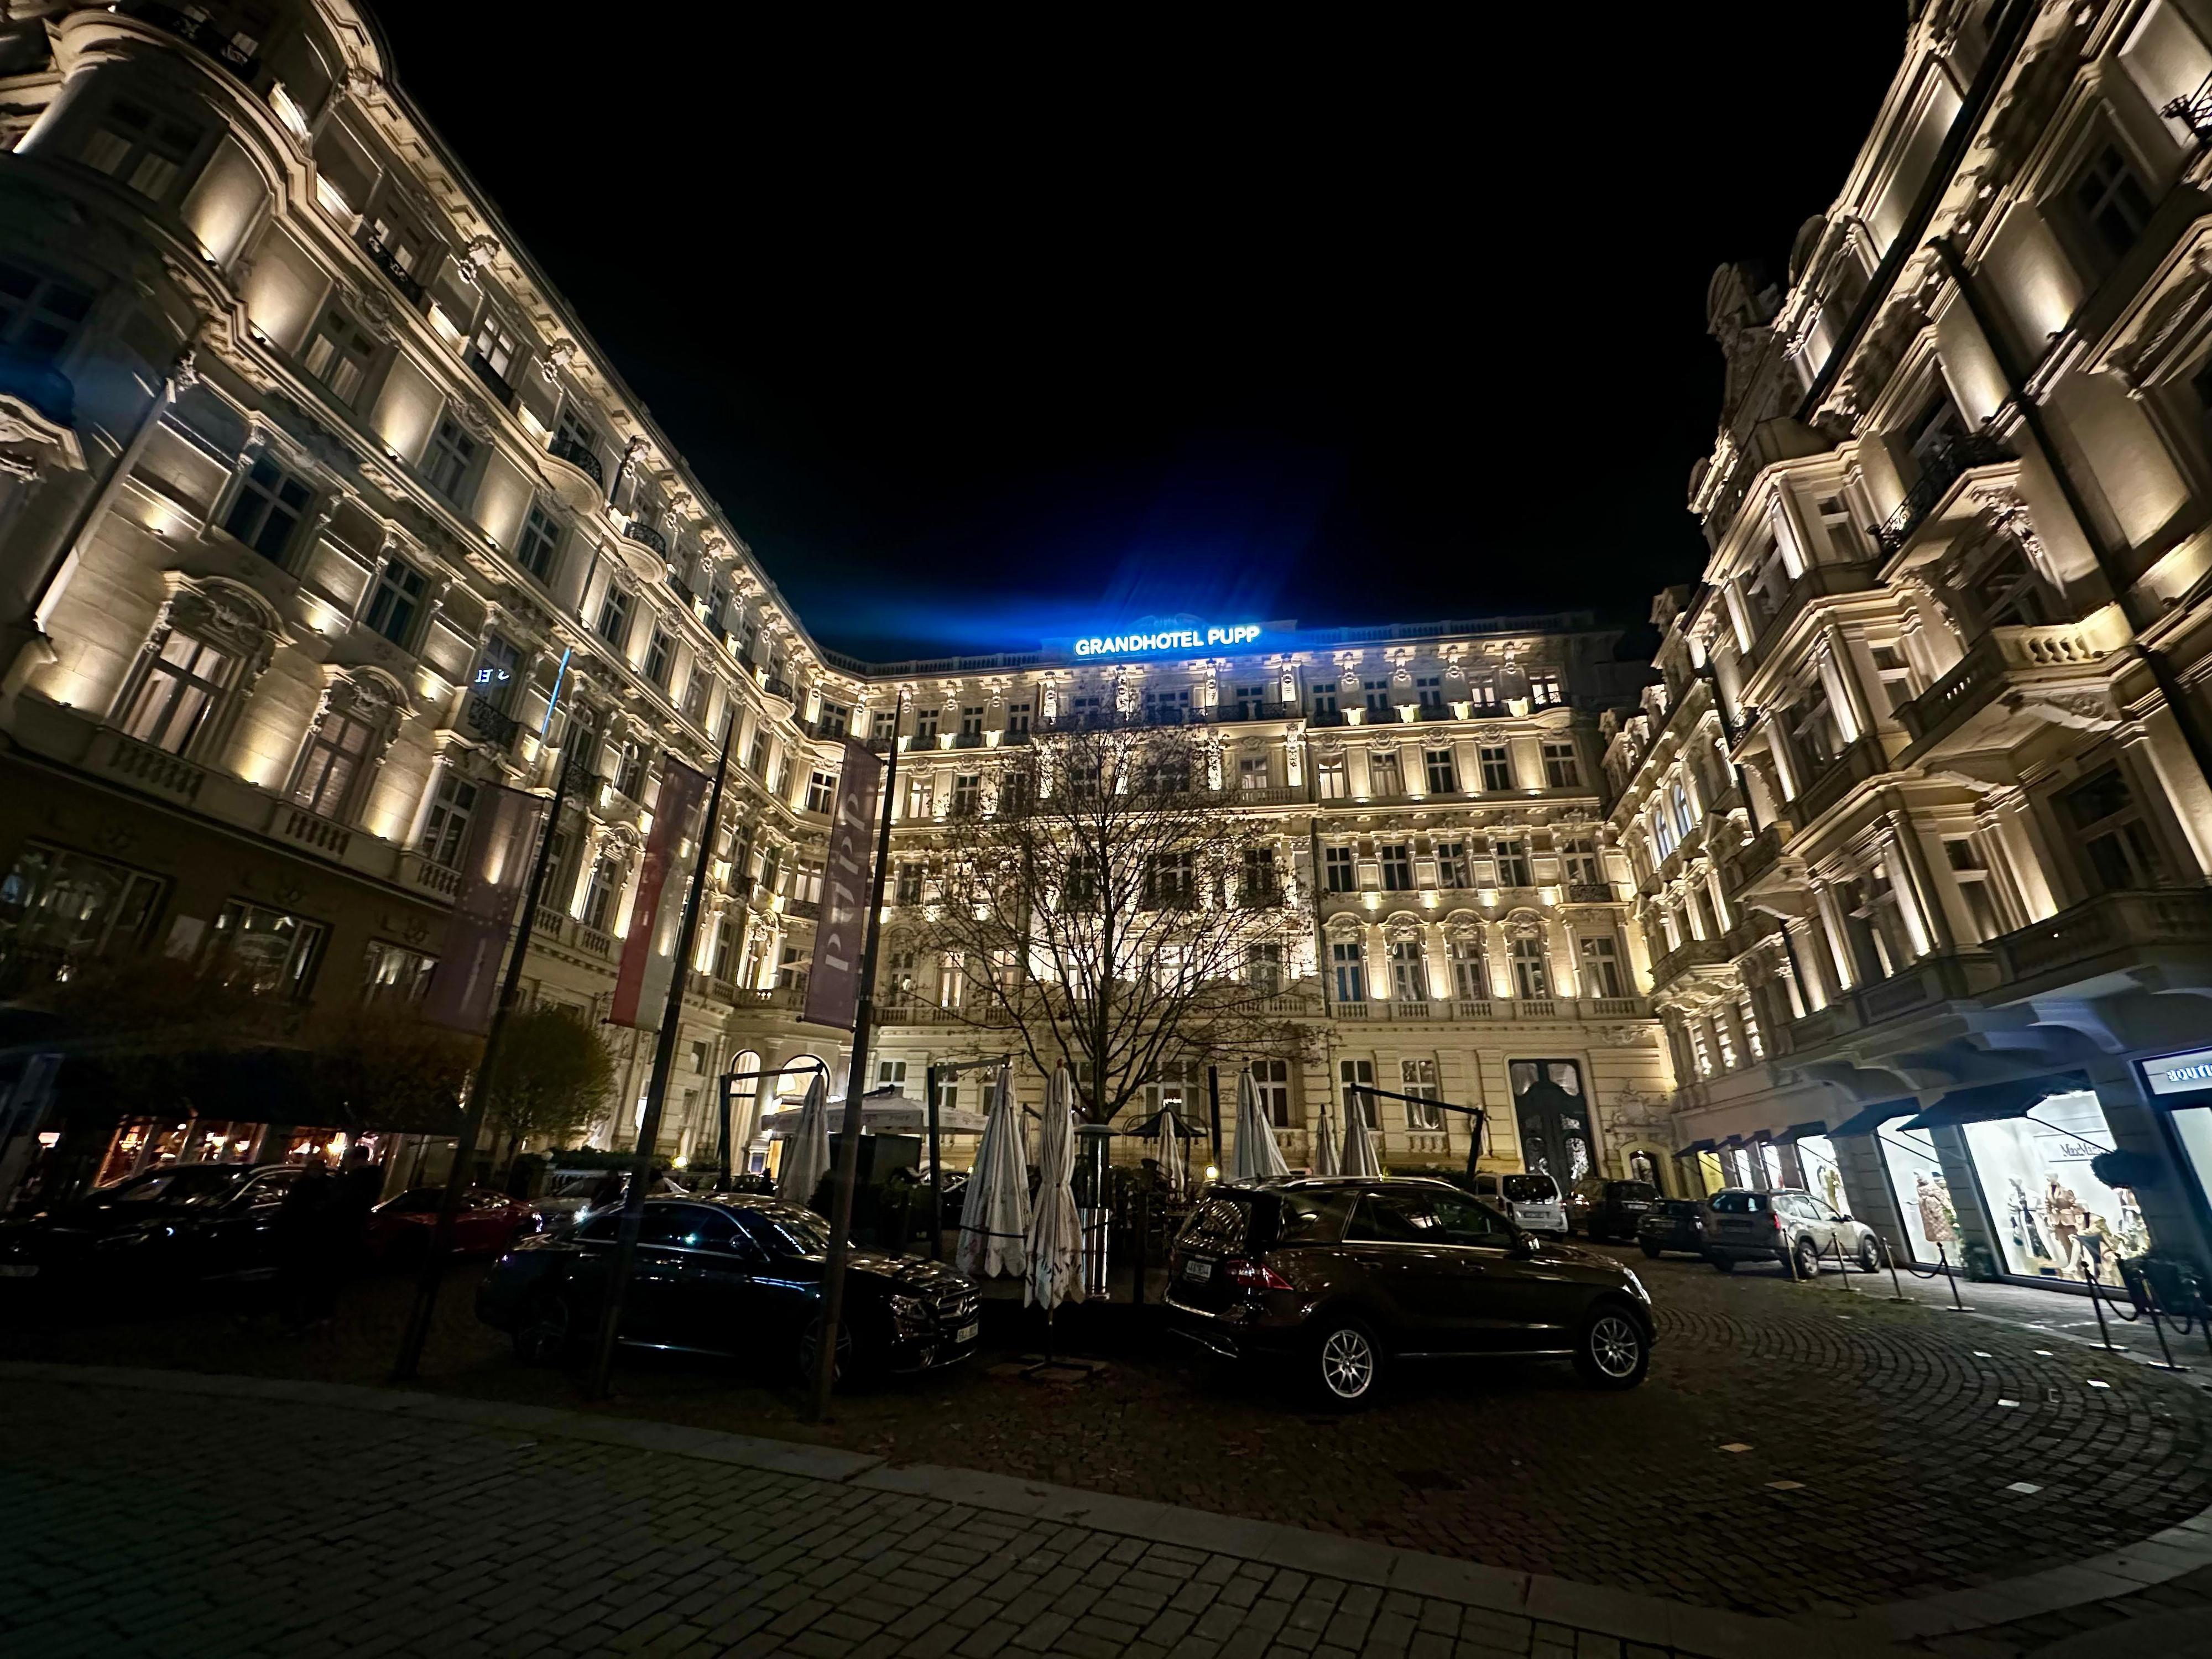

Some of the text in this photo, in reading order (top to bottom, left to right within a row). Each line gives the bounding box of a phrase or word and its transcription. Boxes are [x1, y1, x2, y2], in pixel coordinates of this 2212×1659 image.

[1075, 626, 1260, 655] GRANDHOTEL PUPP
[825, 792, 865, 972] PUPP
[2167, 1064, 2212, 1082] BOUTI
